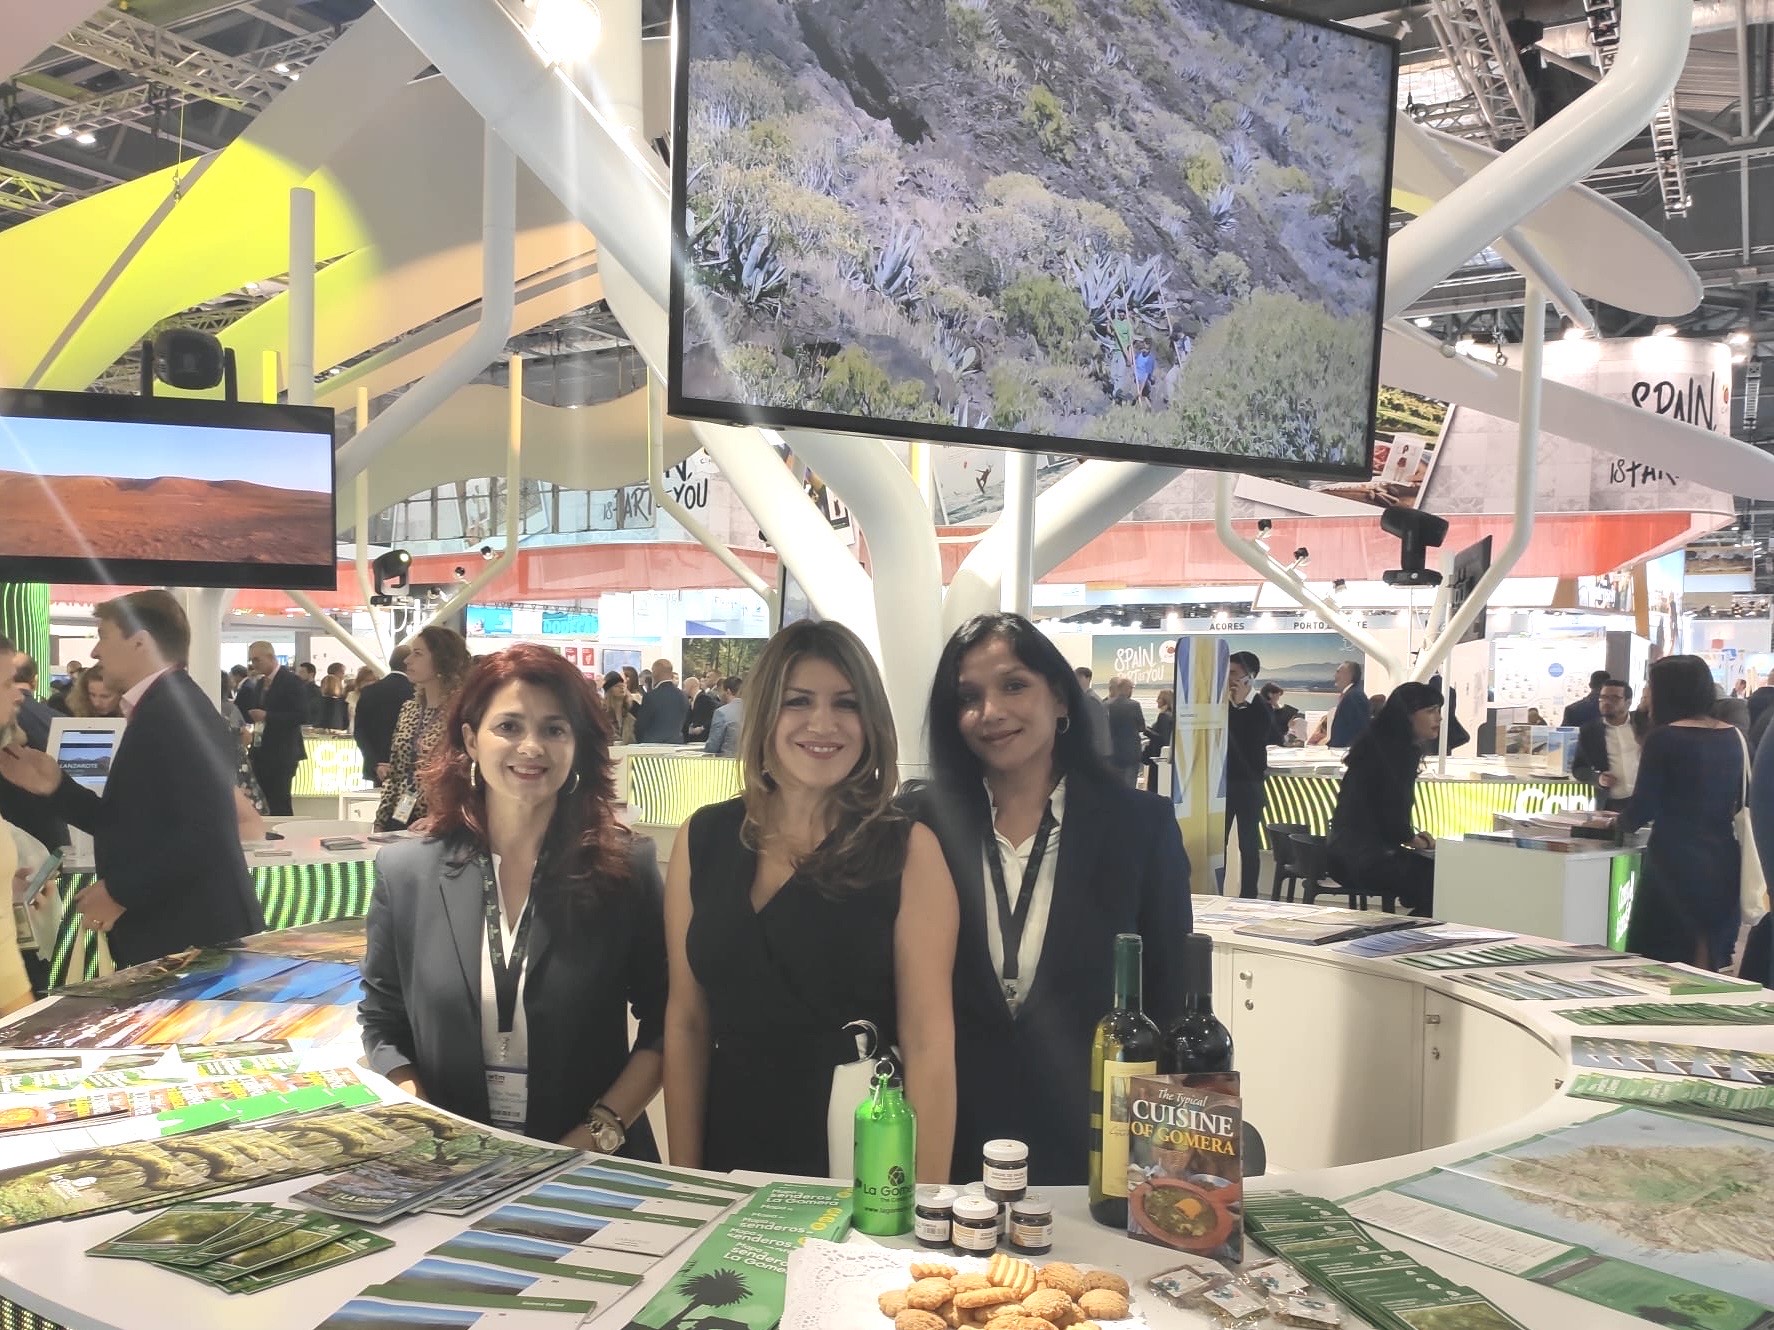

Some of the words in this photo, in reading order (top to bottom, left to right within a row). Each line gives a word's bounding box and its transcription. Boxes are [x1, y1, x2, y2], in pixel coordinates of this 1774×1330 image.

[673, 478, 708, 509] YOU
[1293, 621, 1325, 630] PORTO
[1114, 643, 1156, 673] SPAIN
[1158, 1088, 1174, 1101] The
[1176, 1093, 1209, 1108] Typical
[1132, 1099, 1234, 1137] CUISINE
[1131, 1121, 1154, 1138] OF
[1158, 1127, 1236, 1156] GOMERA
[863, 1184, 877, 1195] La
[723, 1252, 741, 1261] La
